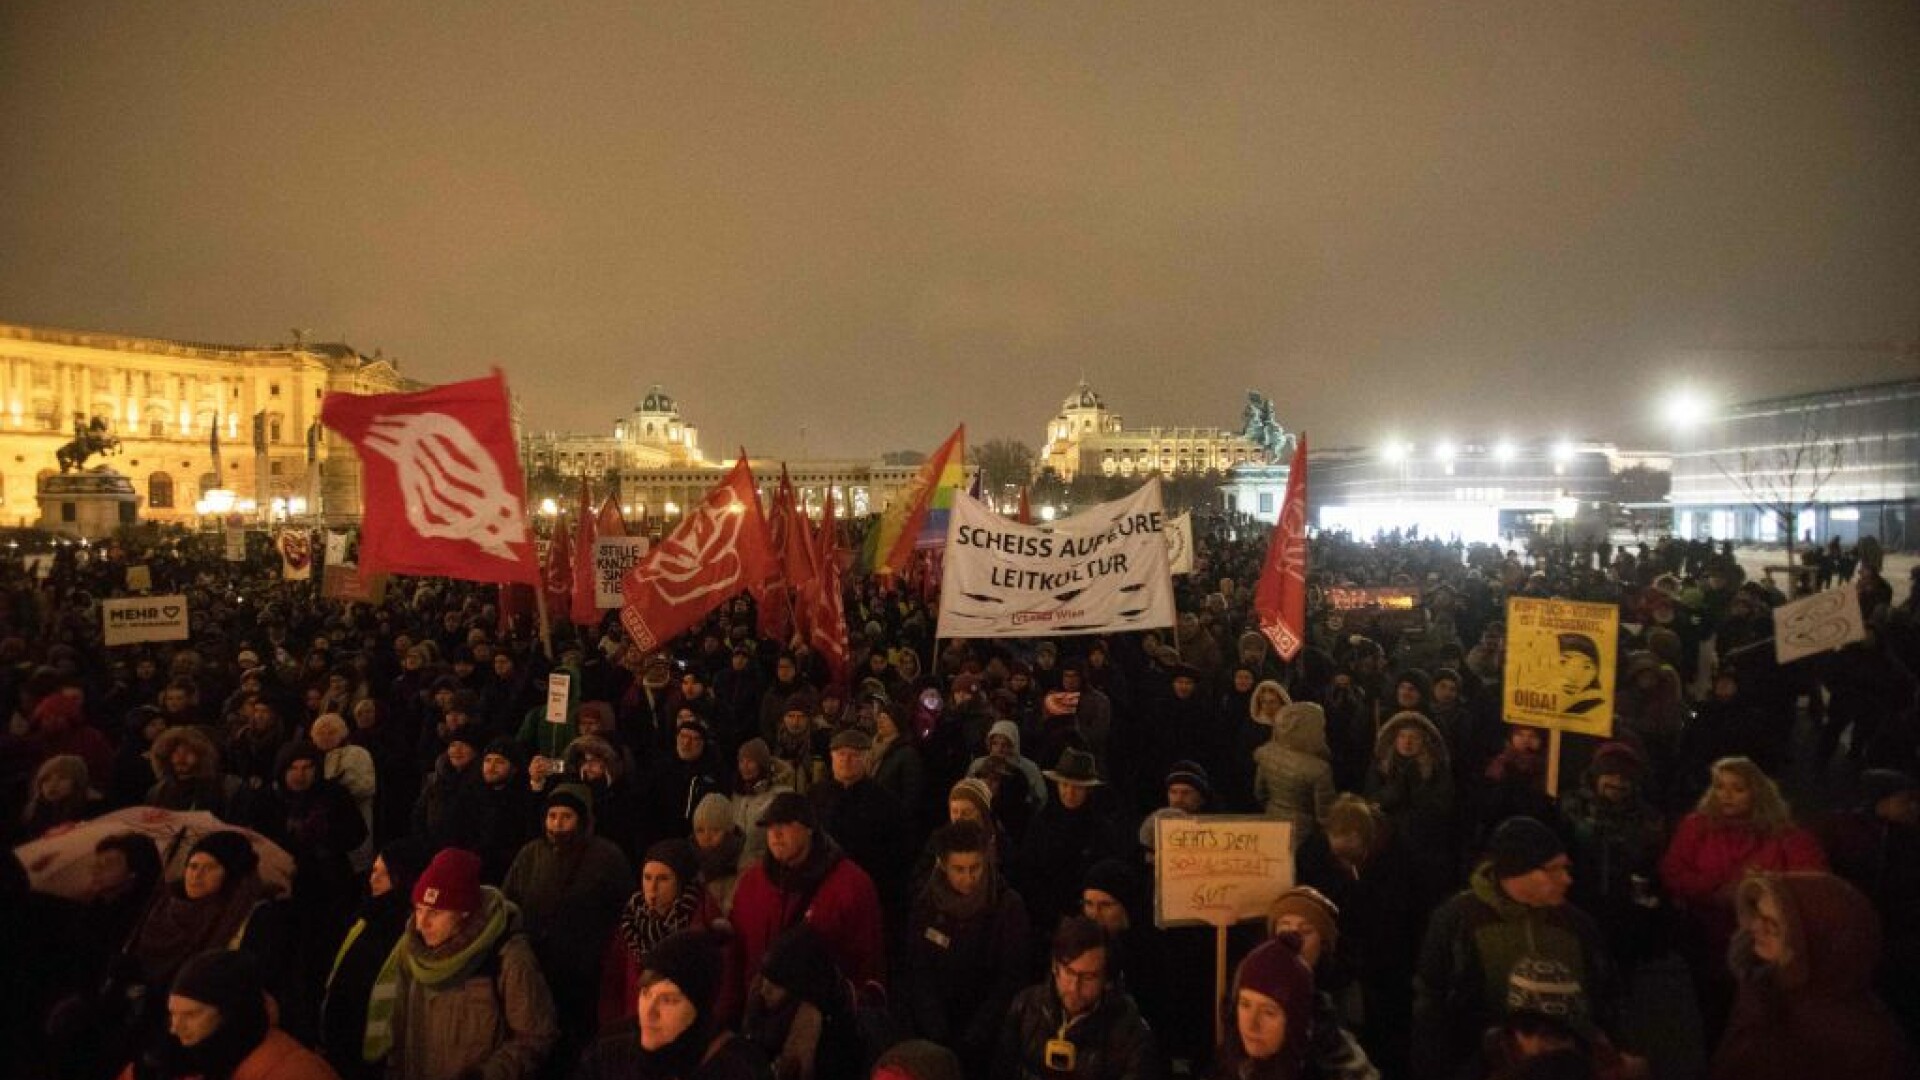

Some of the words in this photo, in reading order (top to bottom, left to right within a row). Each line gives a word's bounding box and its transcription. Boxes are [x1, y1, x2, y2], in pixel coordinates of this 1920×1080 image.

[957, 524, 1053, 559] SCHEISS
[1058, 533, 1107, 559] AUF
[600, 545, 640, 556] STILLE
[602, 569, 622, 581] SIN
[990, 552, 1129, 592] LEITKULTUR
[601, 581, 622, 594] TIE
[110, 607, 158, 621] MEHR
[1193, 883, 1239, 905] GUT
